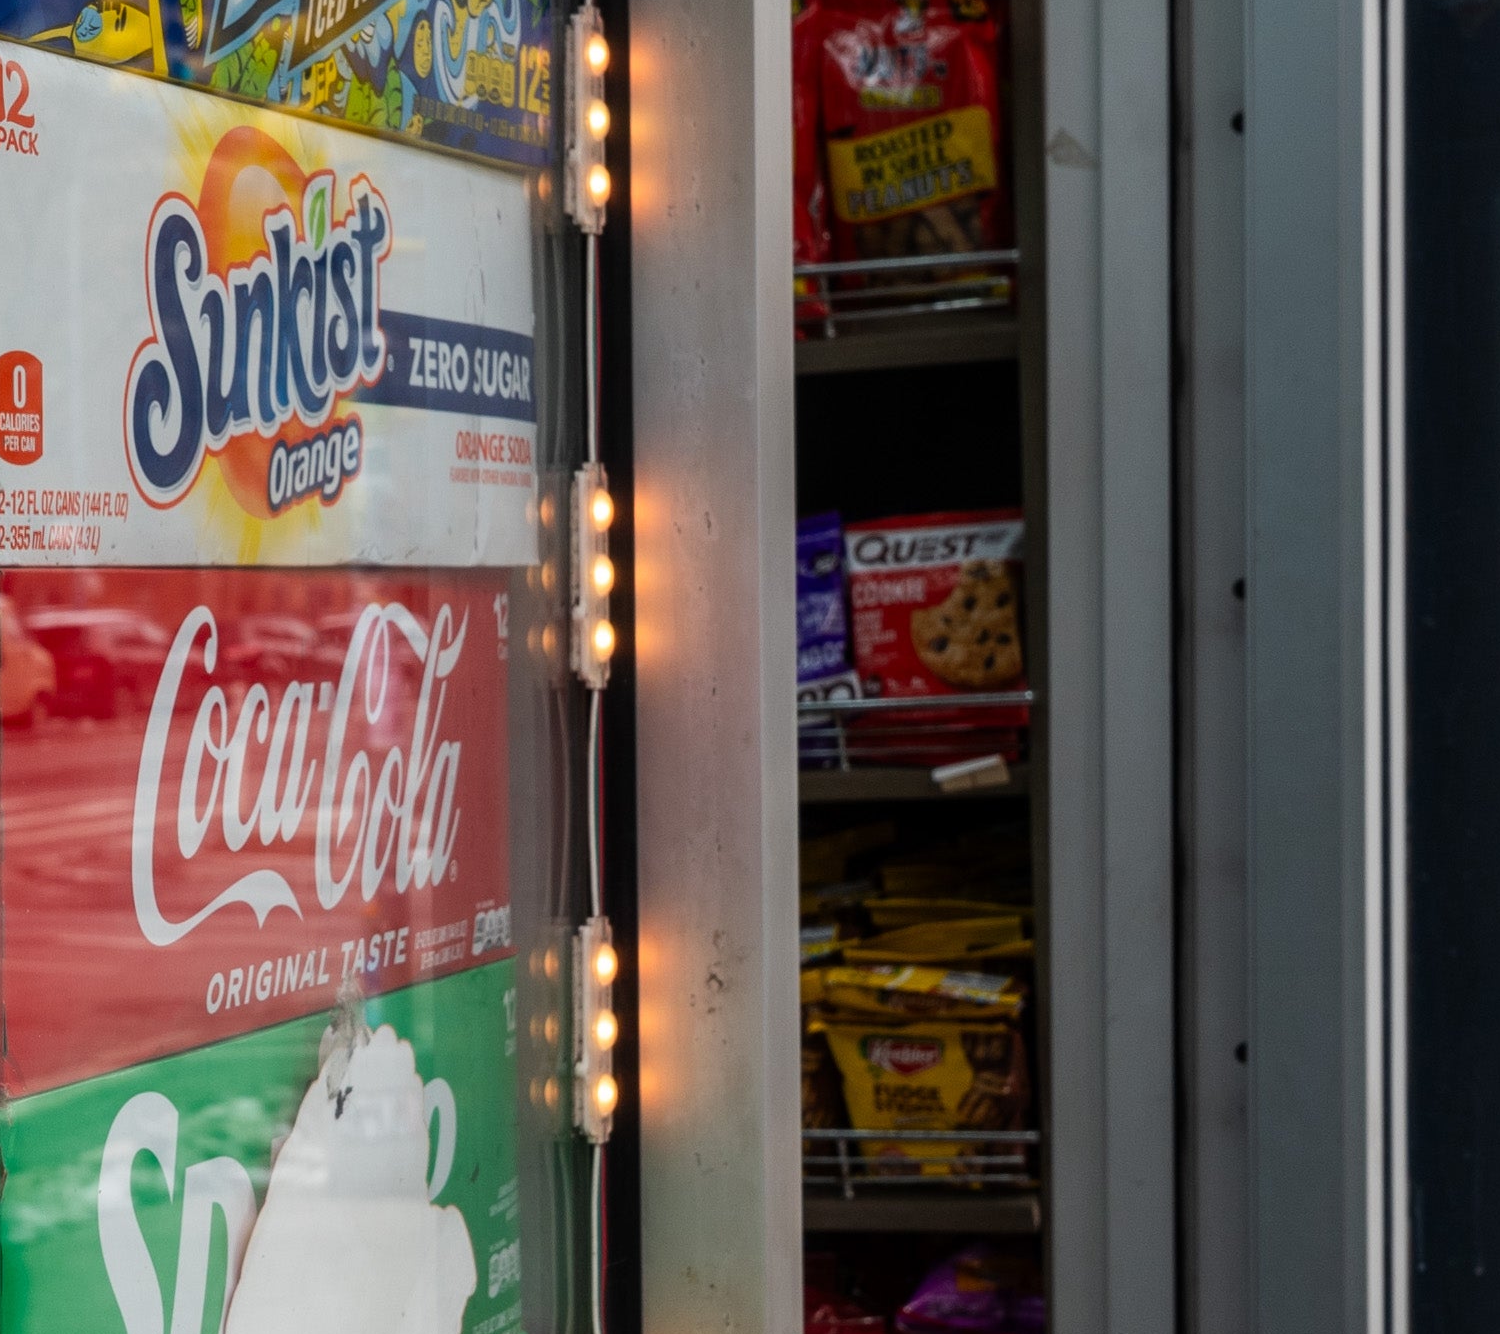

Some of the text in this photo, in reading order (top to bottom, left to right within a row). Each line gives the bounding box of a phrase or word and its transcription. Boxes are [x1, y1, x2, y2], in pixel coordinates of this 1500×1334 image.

[848, 158, 973, 214] PEANUTS
[130, 187, 388, 493] Sunkist
[409, 337, 531, 402] ZERO SUGAR
[13, 365, 26, 409] 0
[0, 413, 40, 432] CALORIES
[270, 424, 359, 506] Orange
[855, 533, 977, 565] QUEST
[132, 602, 468, 947] Coca-Cola
[206, 950, 330, 1015] ORIGINAL
[341, 927, 409, 982] TASTE
